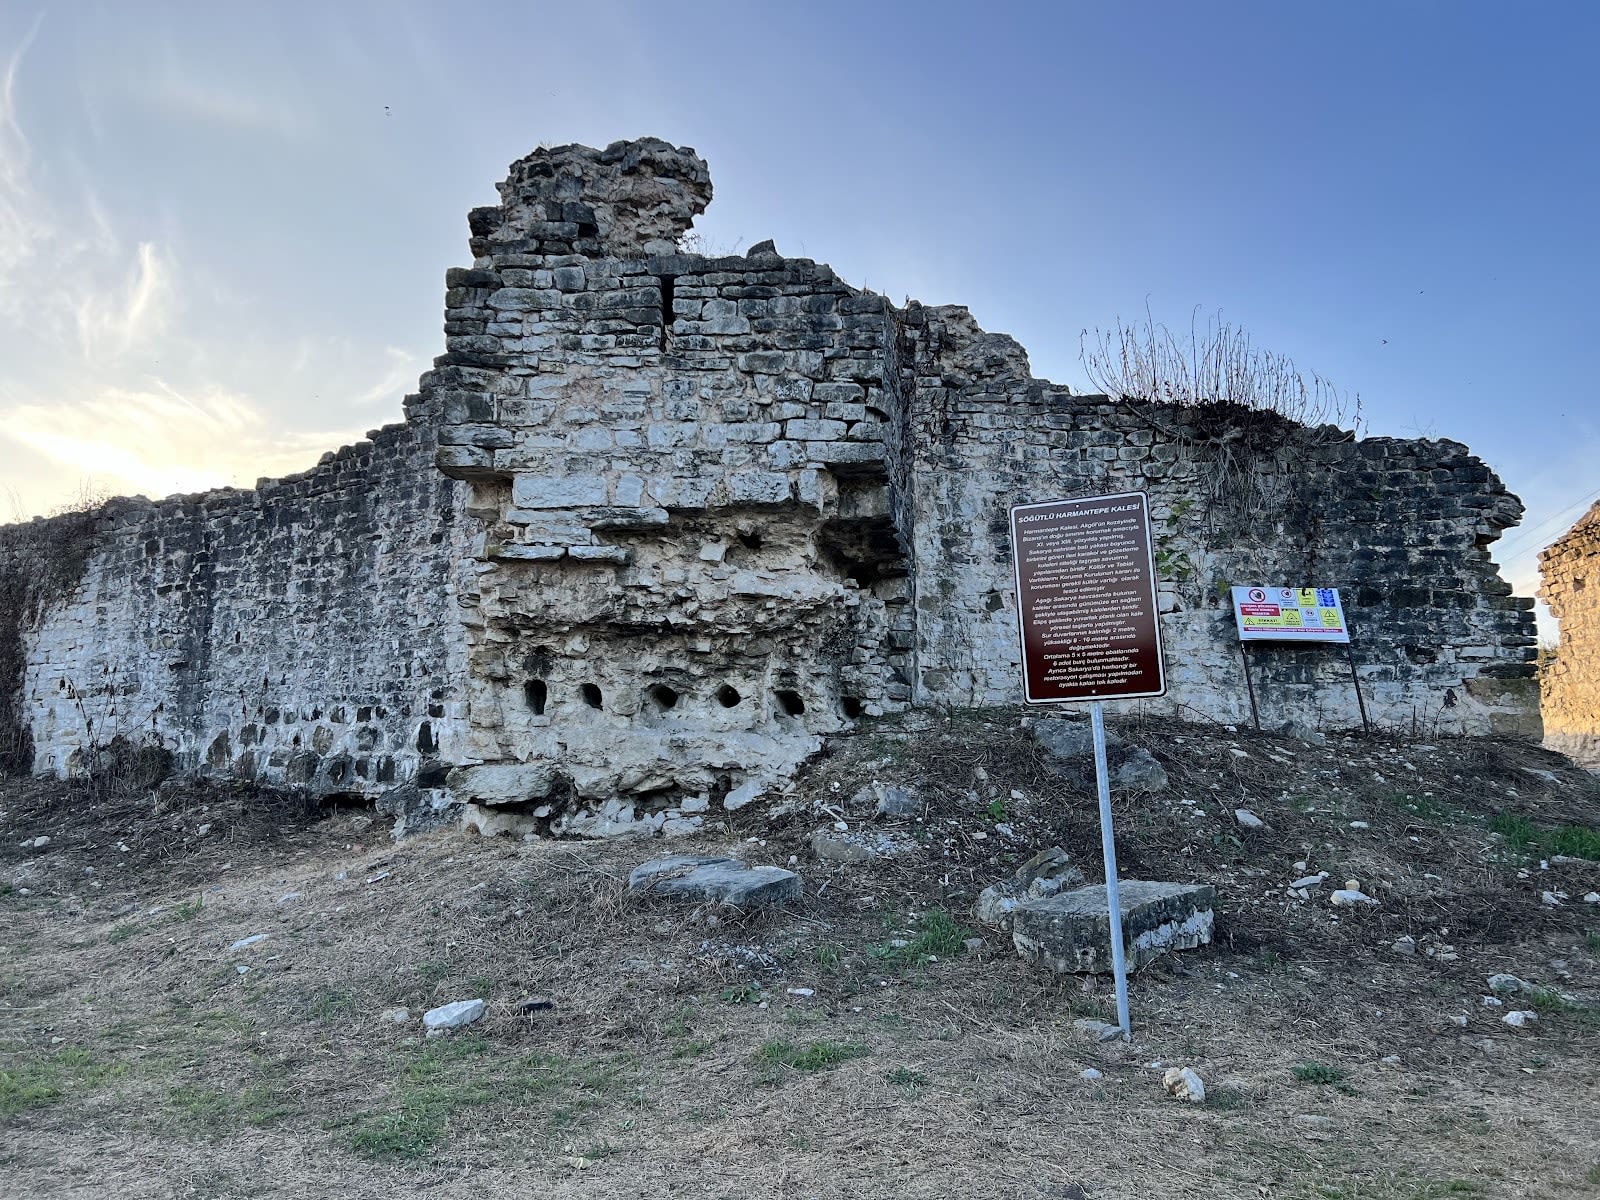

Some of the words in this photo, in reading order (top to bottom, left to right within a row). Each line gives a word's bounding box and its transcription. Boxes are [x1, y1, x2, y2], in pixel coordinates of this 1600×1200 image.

[1056, 508, 1110, 519] HARMANTEPE
[1111, 503, 1140, 513] KALESİ
[1108, 547, 1140, 555] gözetleme
